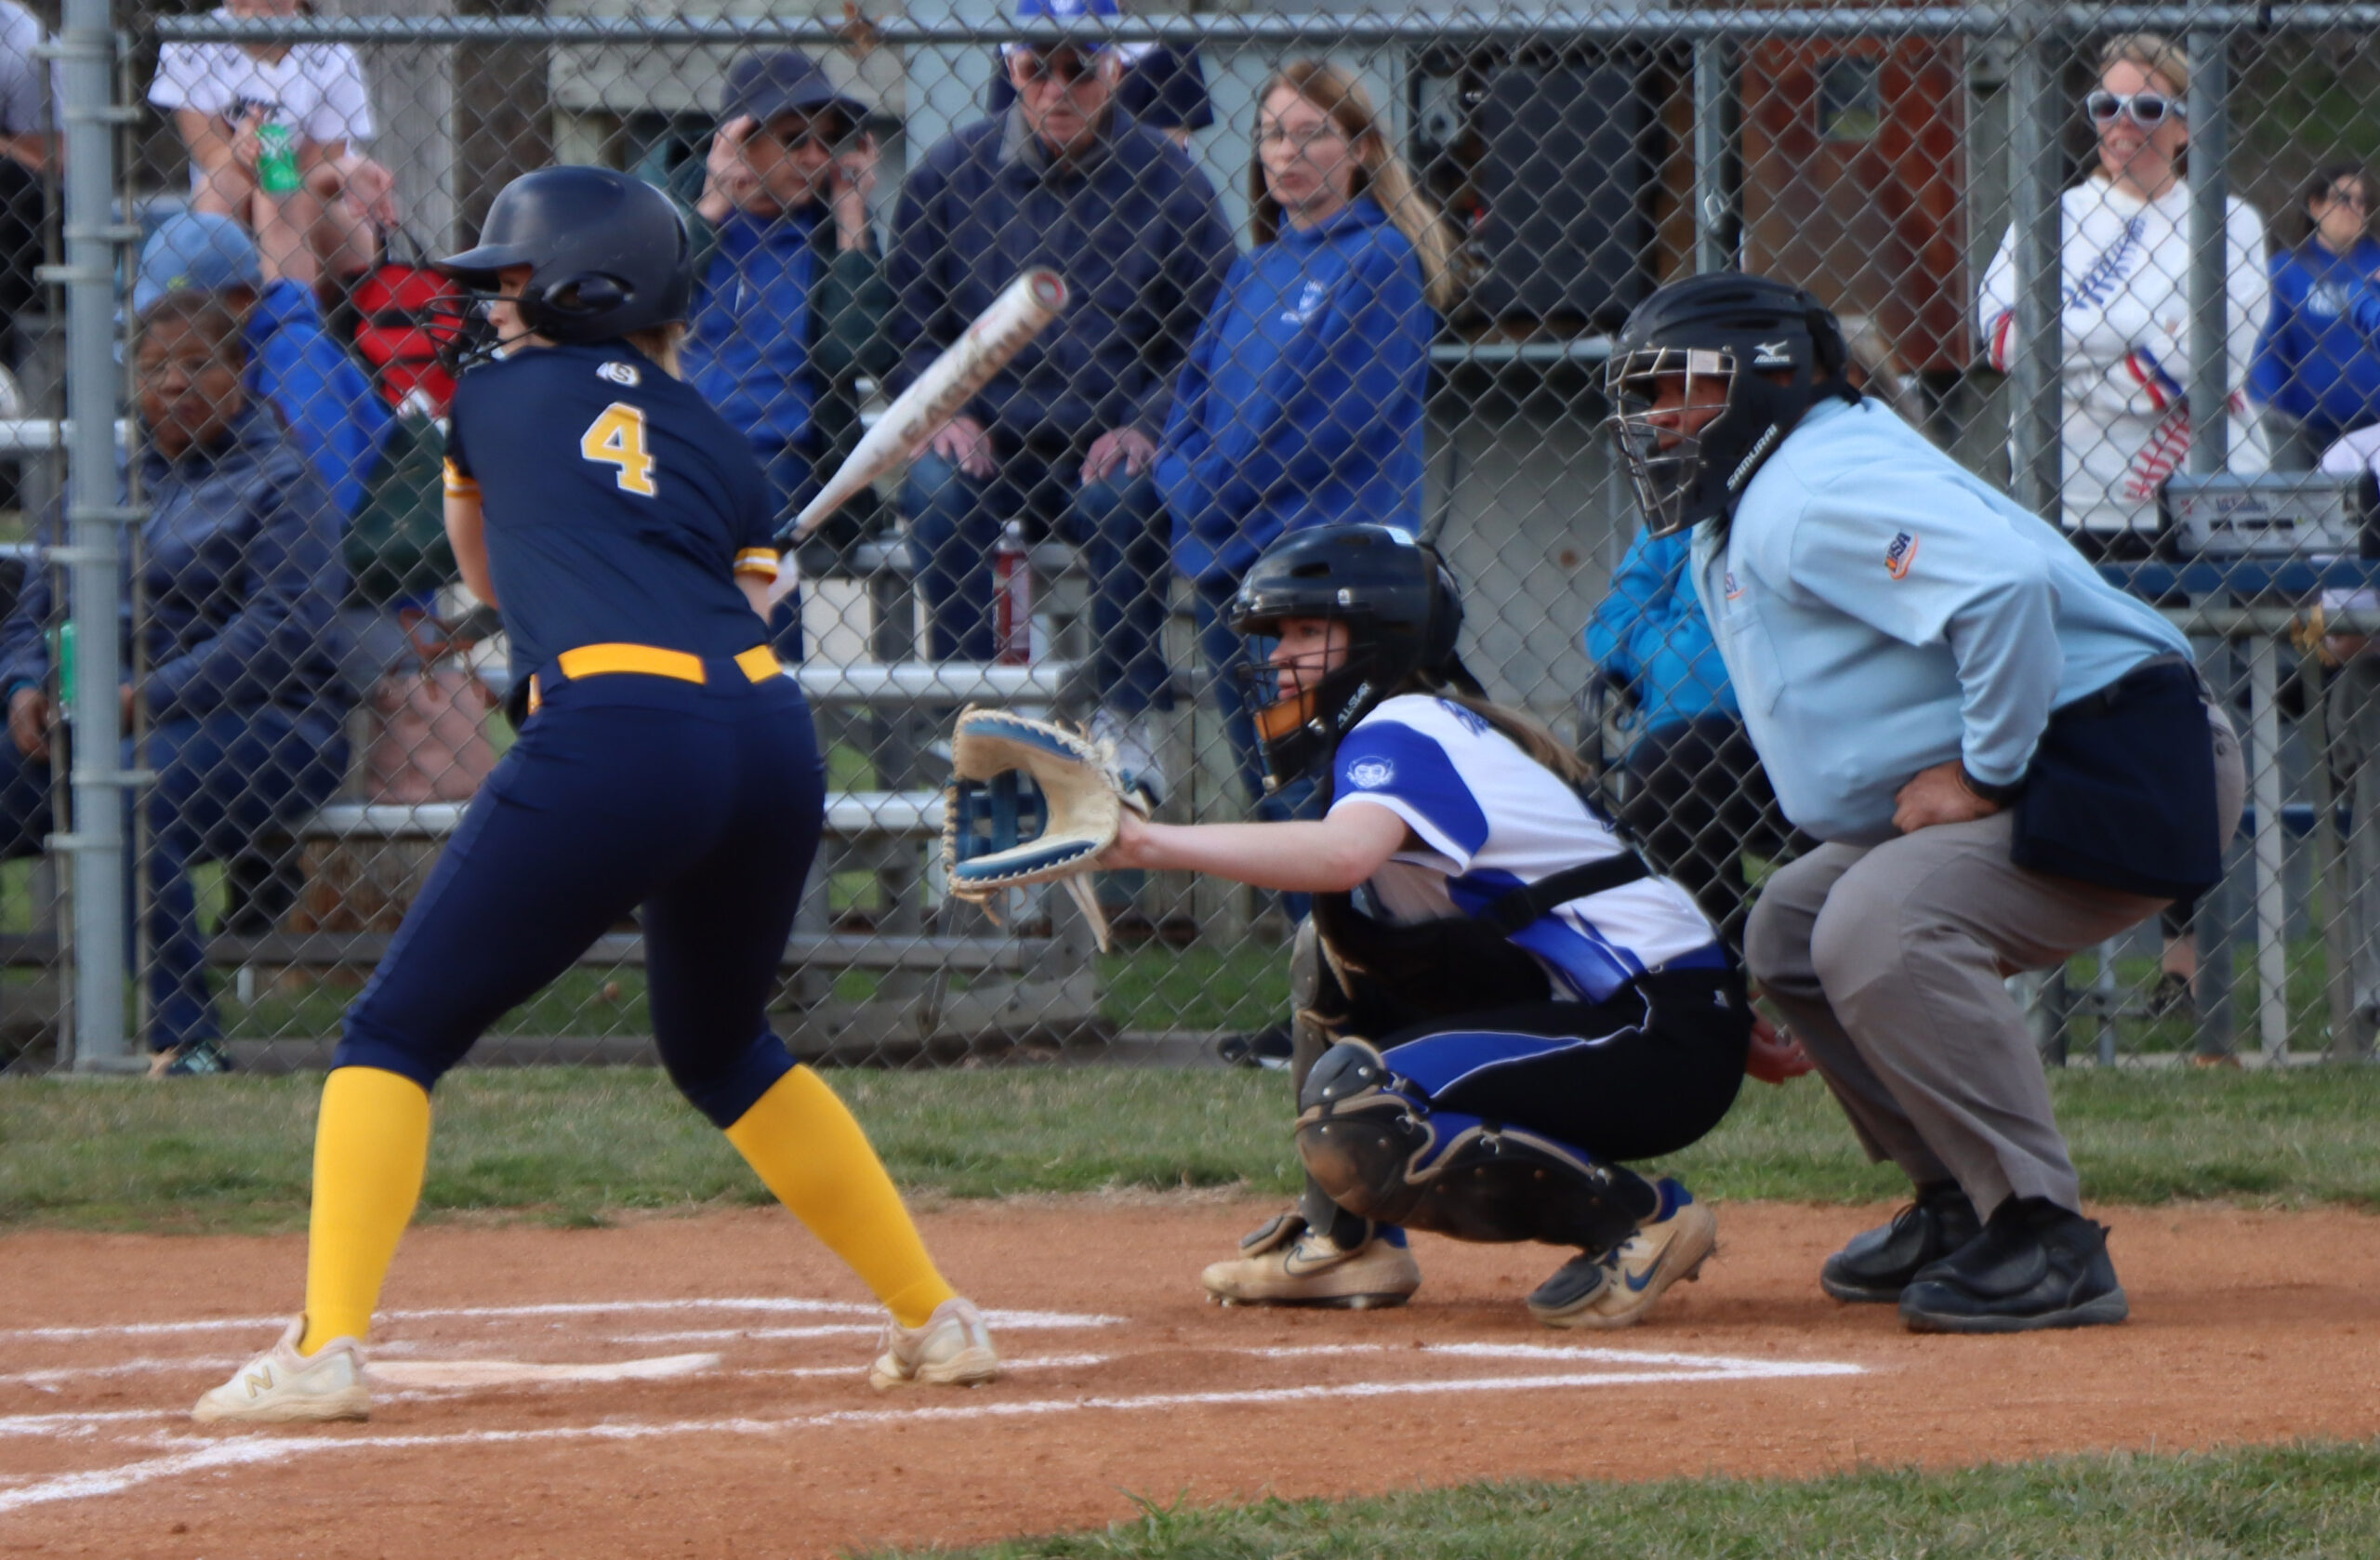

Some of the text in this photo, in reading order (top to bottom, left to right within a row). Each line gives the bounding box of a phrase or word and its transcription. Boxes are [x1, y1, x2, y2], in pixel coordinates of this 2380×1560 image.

[580, 402, 654, 497] 4
[1726, 423, 1778, 491] SAMURAI
[245, 1365, 274, 1398] N
